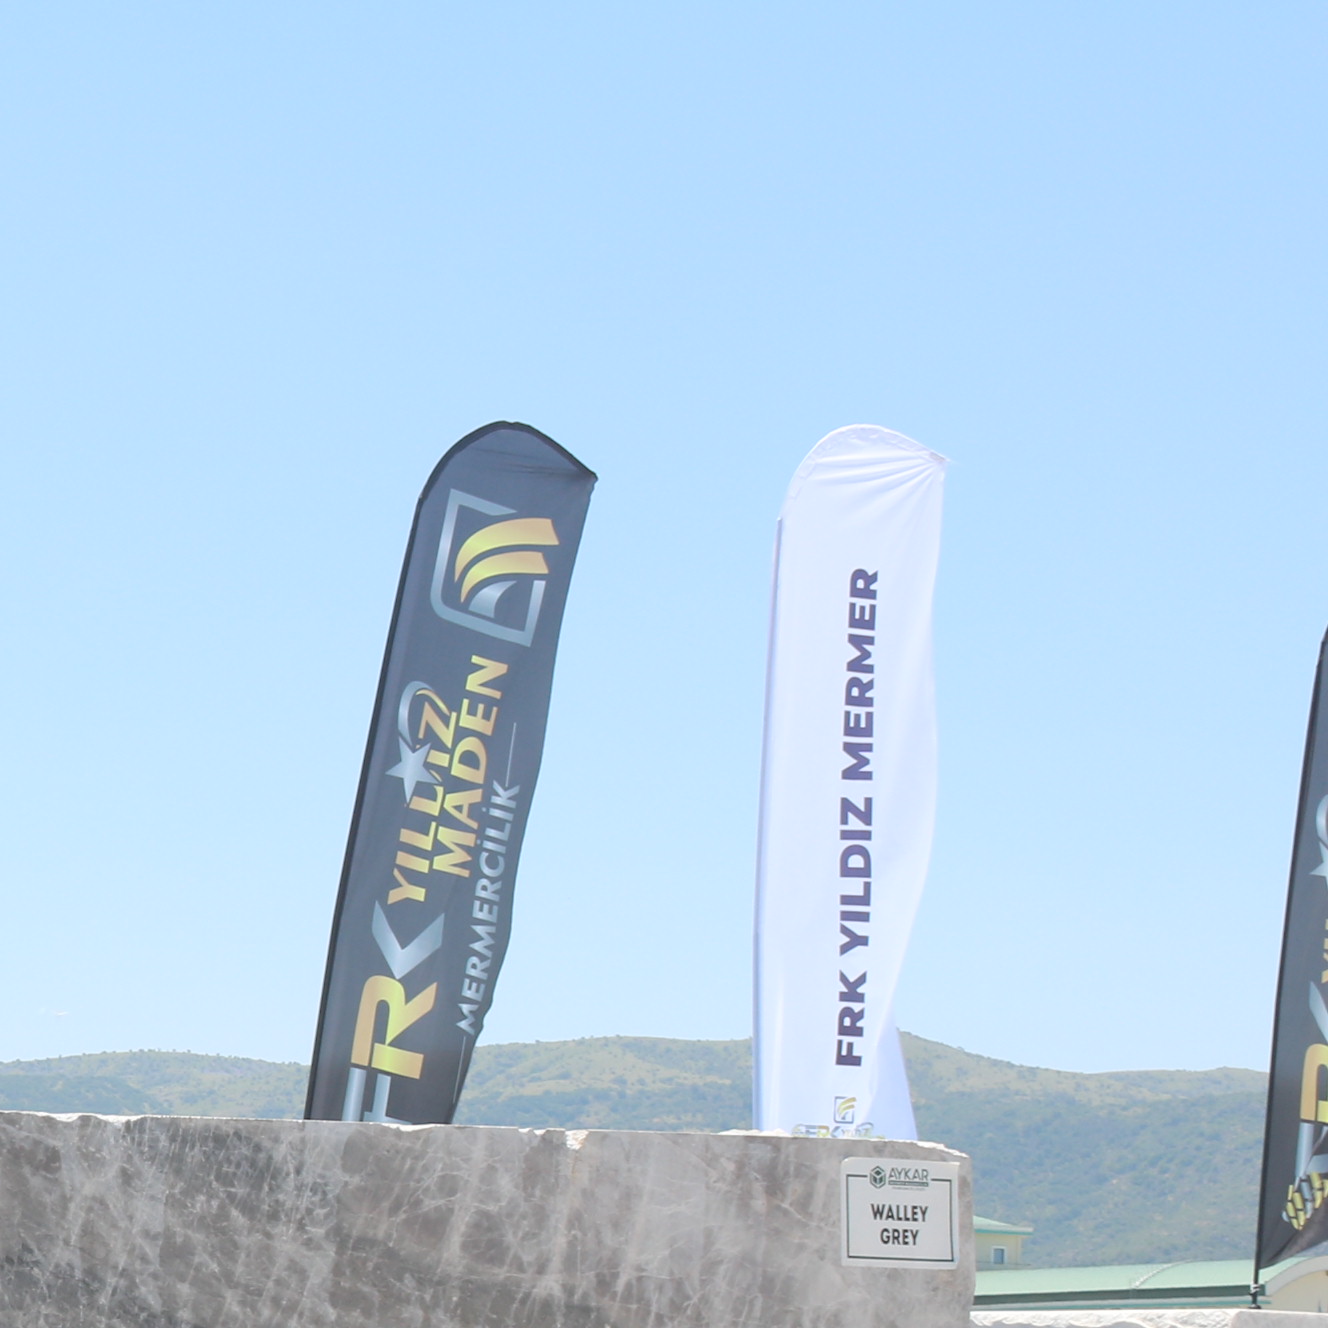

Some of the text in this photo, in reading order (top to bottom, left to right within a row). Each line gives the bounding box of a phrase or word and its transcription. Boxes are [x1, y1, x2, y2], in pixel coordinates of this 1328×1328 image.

[432, 655, 509, 878] MADEN
[835, 568, 879, 1067] FRK YILDIZ MERMER
[455, 779, 521, 1036] MERMERCİLİK
[870, 1203, 929, 1222] WALLEY
[888, 1167, 929, 1181] AYKAR
[880, 1228, 920, 1246] GREY
